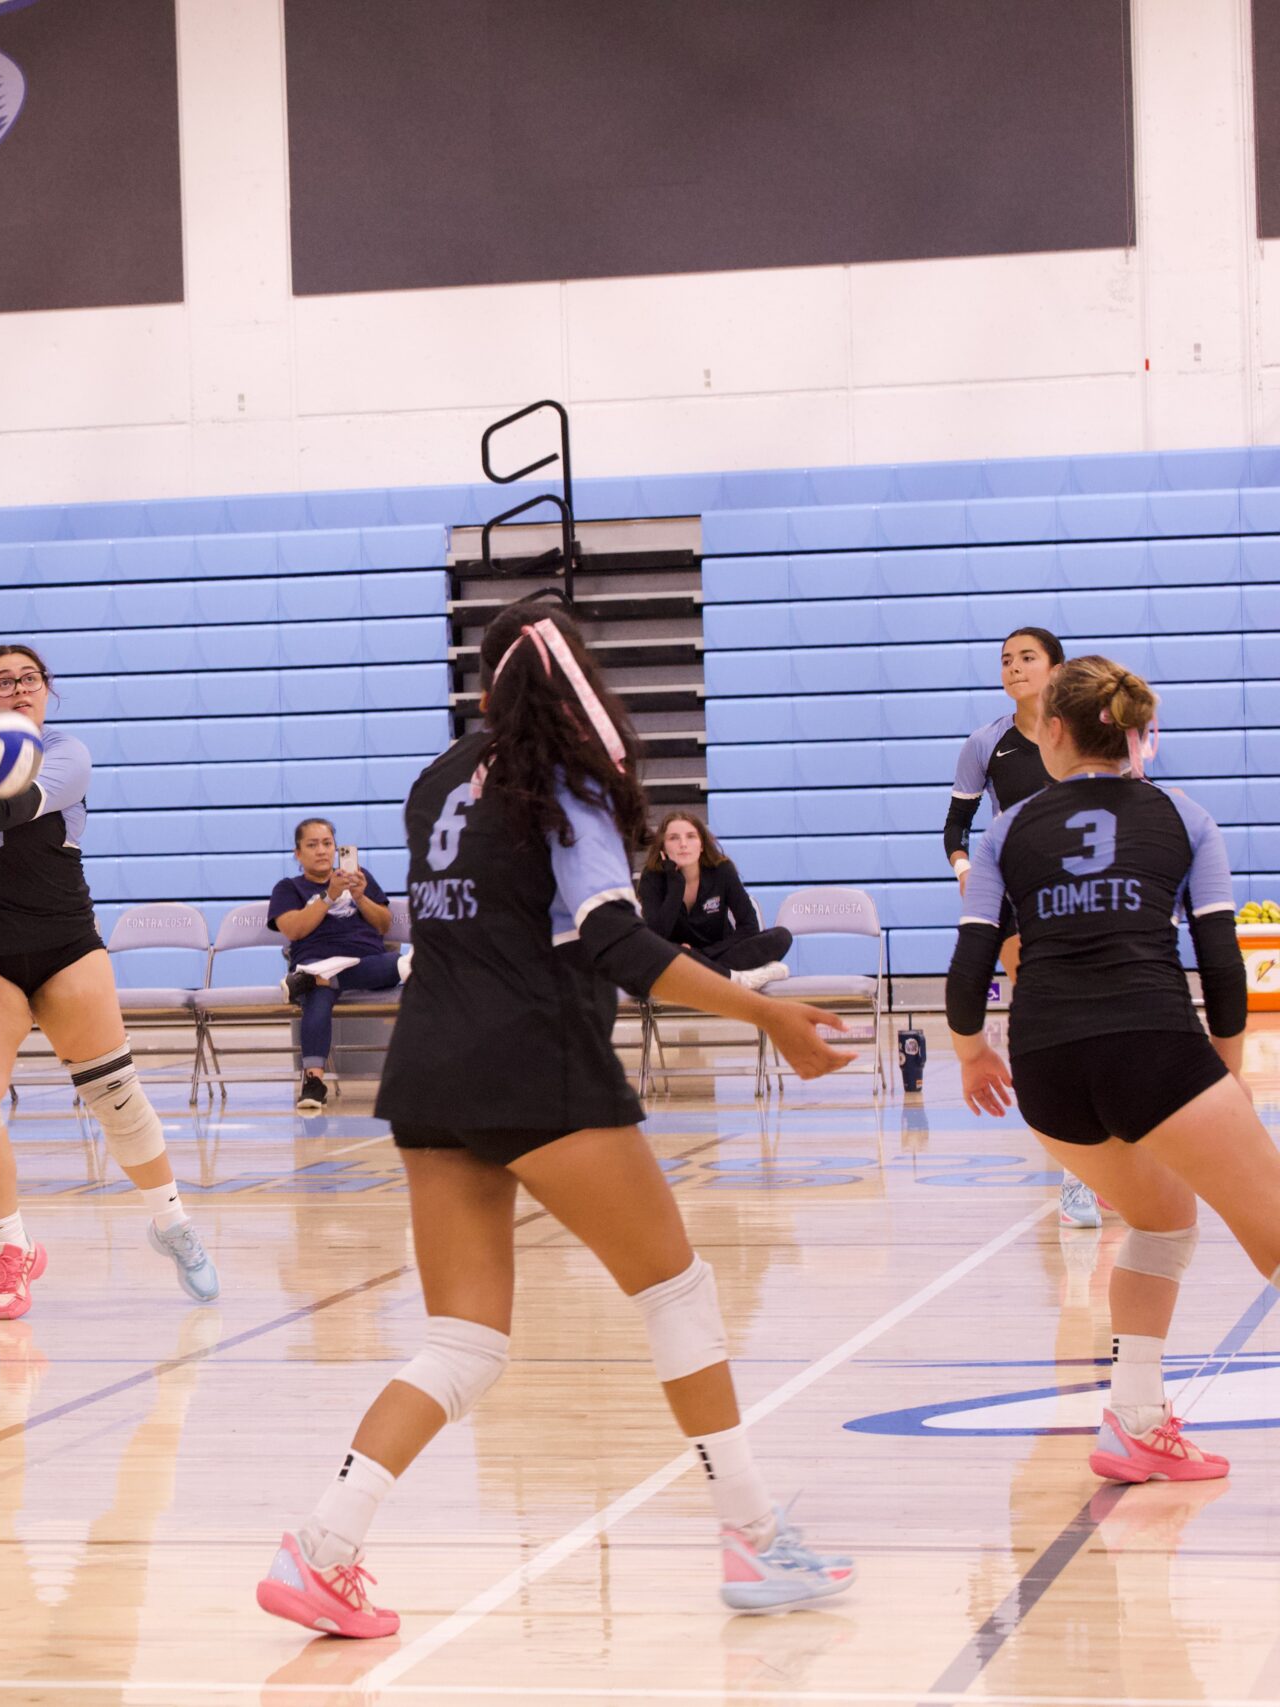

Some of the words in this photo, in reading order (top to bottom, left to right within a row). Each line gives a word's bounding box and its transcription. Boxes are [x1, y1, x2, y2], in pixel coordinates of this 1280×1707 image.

[425, 782, 476, 872] 6
[1061, 807, 1118, 877] 3
[791, 903, 831, 915] CONTRA
[833, 902, 863, 914] COSTA
[1037, 878, 1143, 920] COMETS
[126, 917, 163, 929] CONTRA
[164, 916, 192, 928] COSTA
